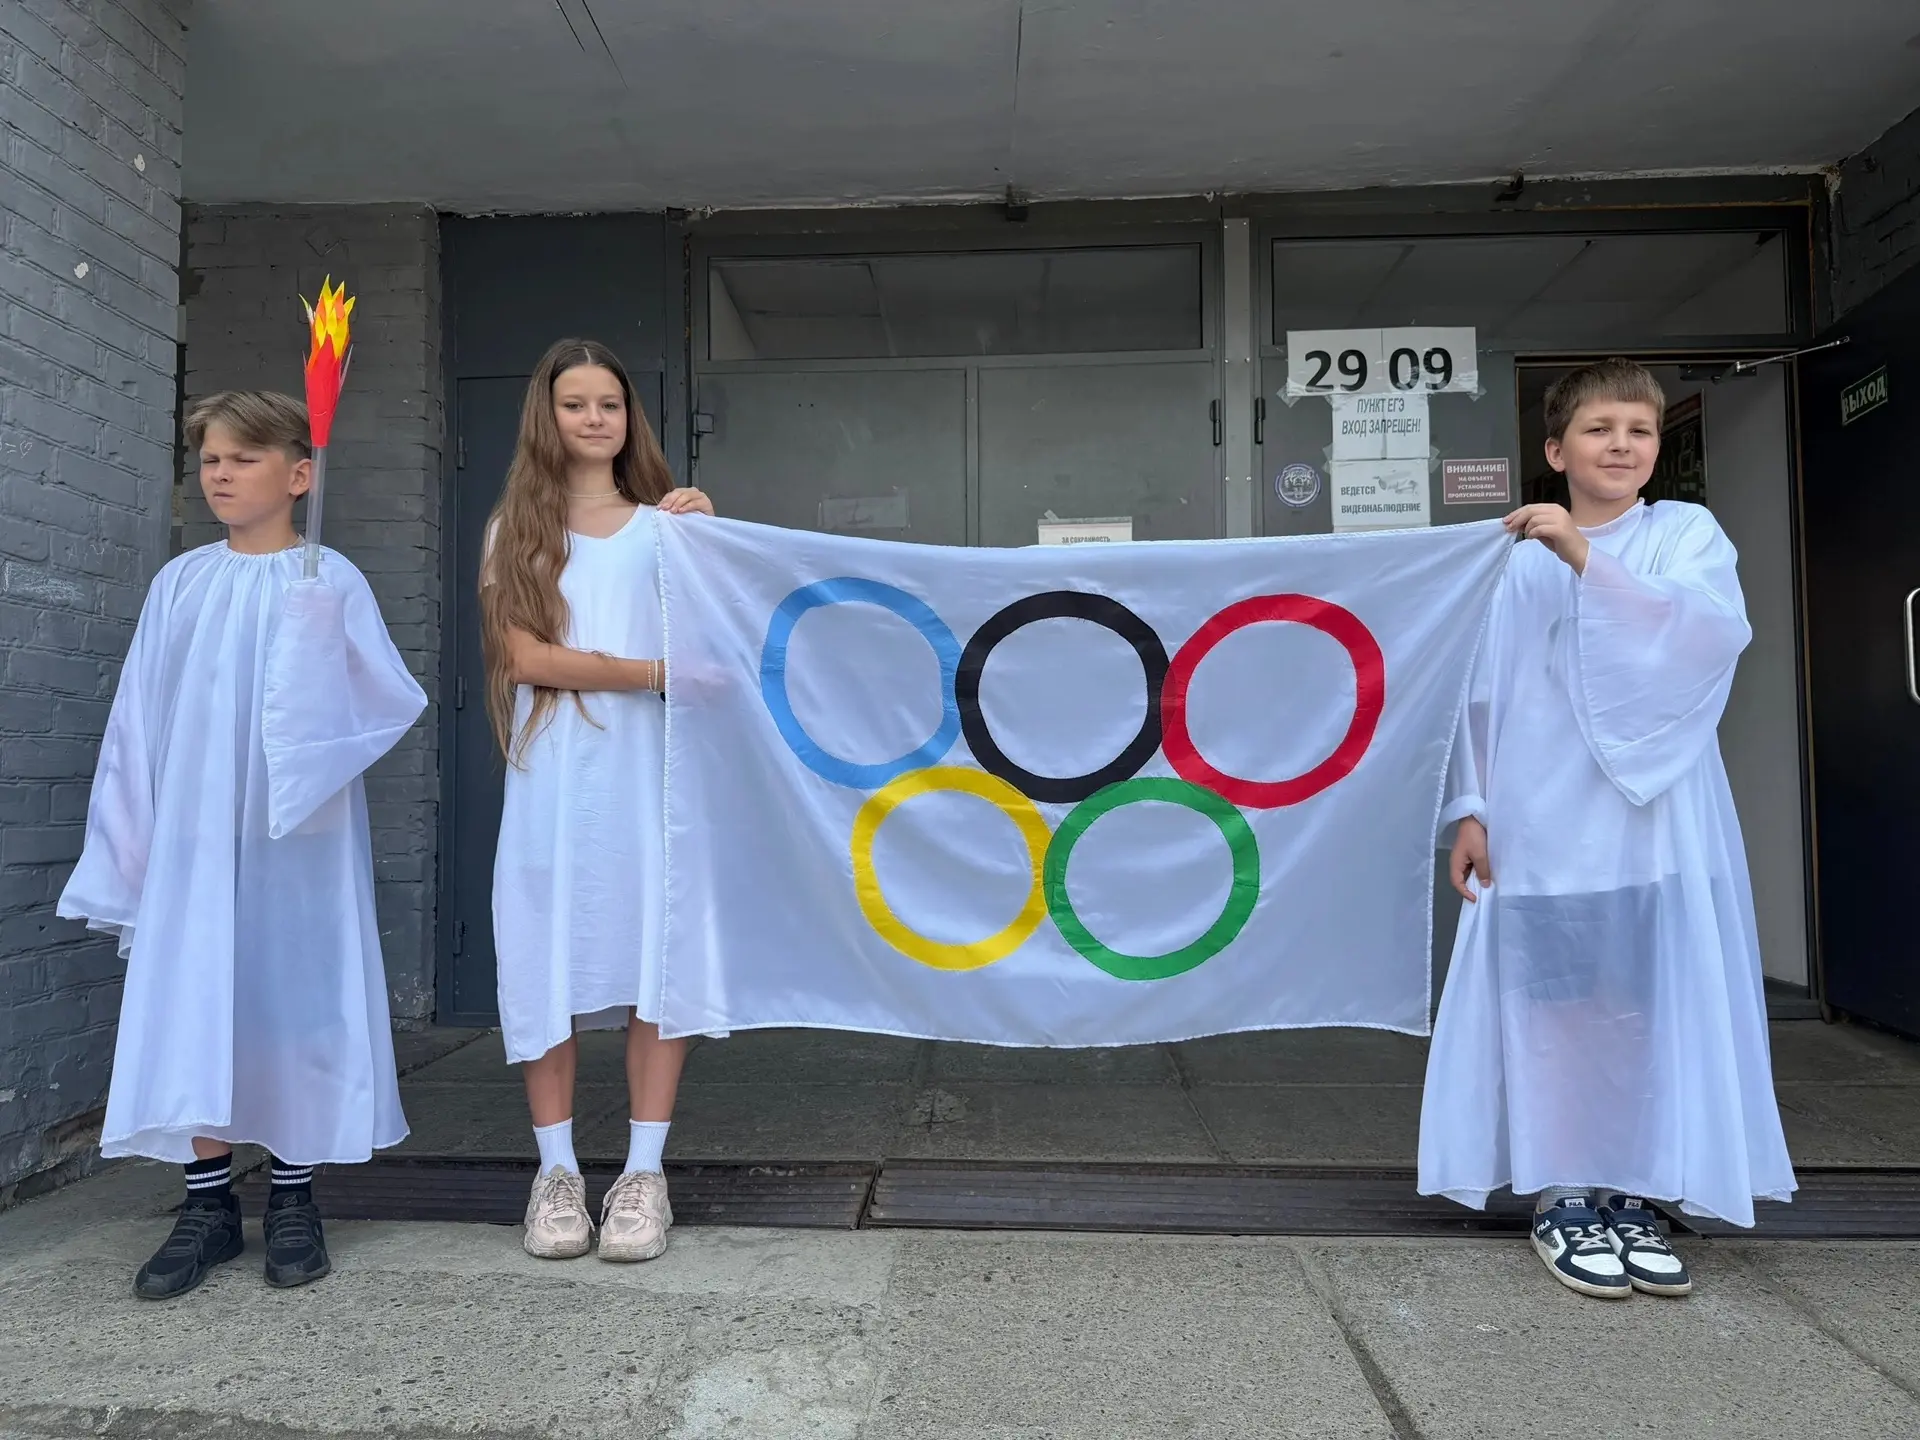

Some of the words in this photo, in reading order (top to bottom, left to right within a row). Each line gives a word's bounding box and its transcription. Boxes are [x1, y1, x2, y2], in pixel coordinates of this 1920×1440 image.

[1305, 349, 1367, 392] 29
[1389, 347, 1452, 390] 09
[1842, 375, 1885, 415] ВЫХОД
[1357, 398, 1386, 413] ПУНКТ
[1387, 398, 1404, 412] ЕГЭ
[1341, 419, 1367, 437] ВХОД
[1369, 418, 1421, 436] ЗАПРЕЩЕН!
[1446, 464, 1505, 473] ВНИМАНИЕ!
[1340, 486, 1375, 496] ВЕДЕТСЯ
[1341, 503, 1421, 514] ВИДЕОНАБЛЮДЕНИЕ
[1536, 1219, 1551, 1234] FILA
